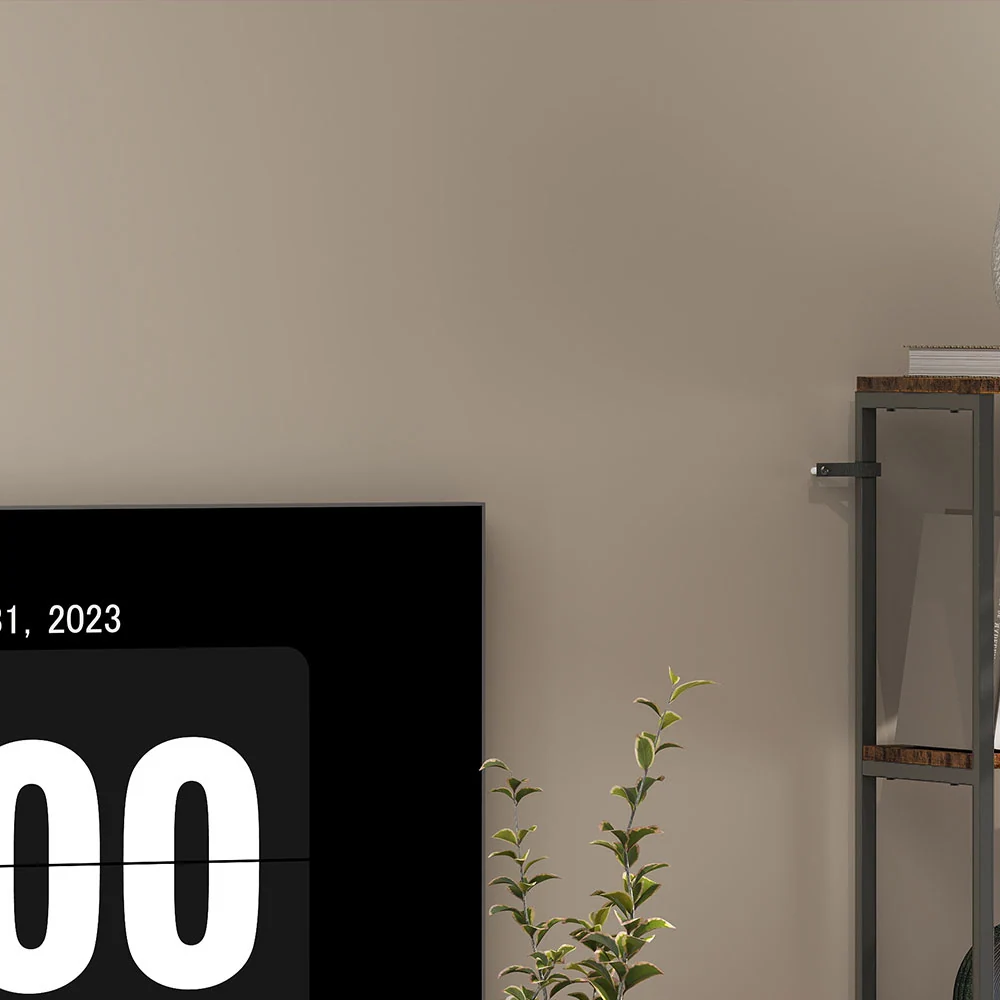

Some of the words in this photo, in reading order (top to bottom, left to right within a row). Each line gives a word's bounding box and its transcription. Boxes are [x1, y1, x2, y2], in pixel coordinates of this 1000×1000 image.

[0, 604, 30, 638] 1,
[48, 603, 121, 634] 2023
[0, 736, 260, 995] 00
